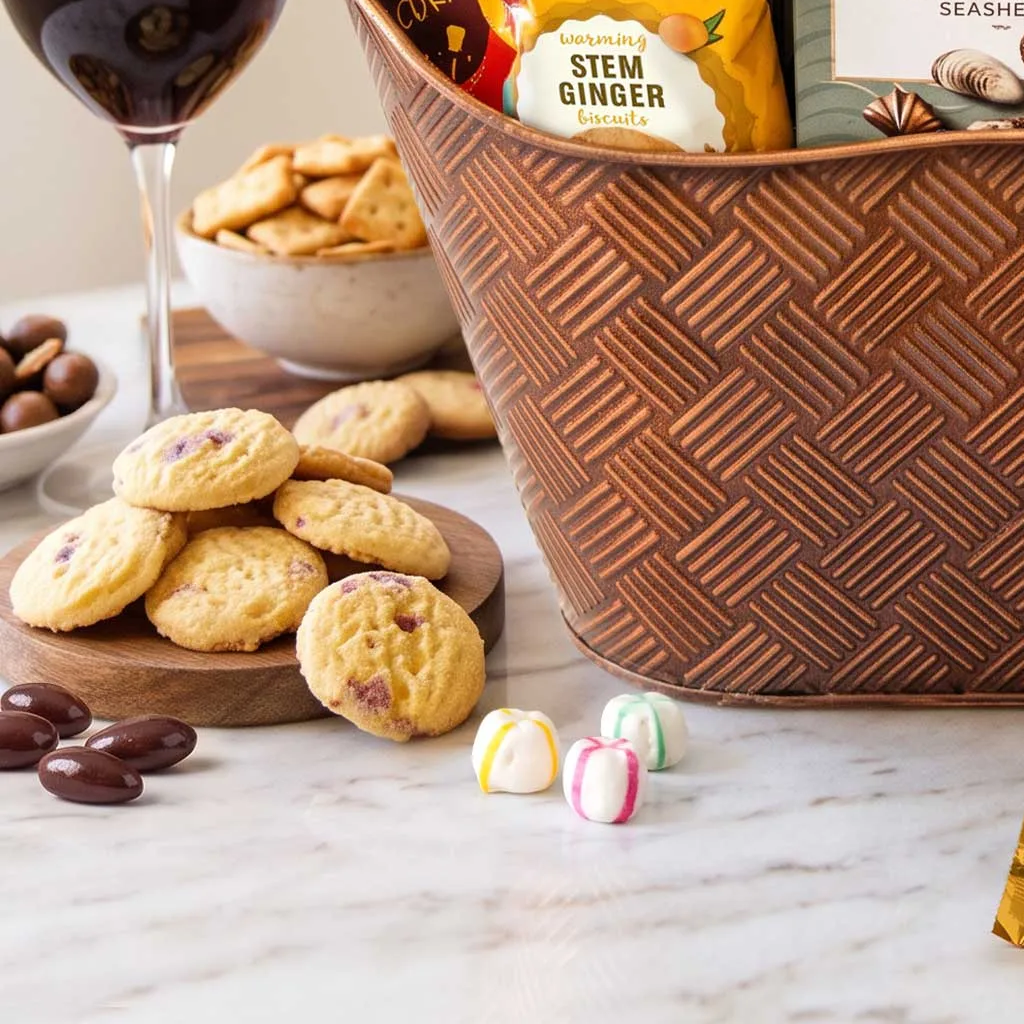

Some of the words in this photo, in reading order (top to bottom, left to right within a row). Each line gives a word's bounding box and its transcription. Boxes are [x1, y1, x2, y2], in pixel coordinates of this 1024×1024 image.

[560, 32, 647, 53] warming
[570, 53, 644, 79] STEM
[559, 81, 665, 108] GINGER
[577, 108, 648, 126] biscuits
